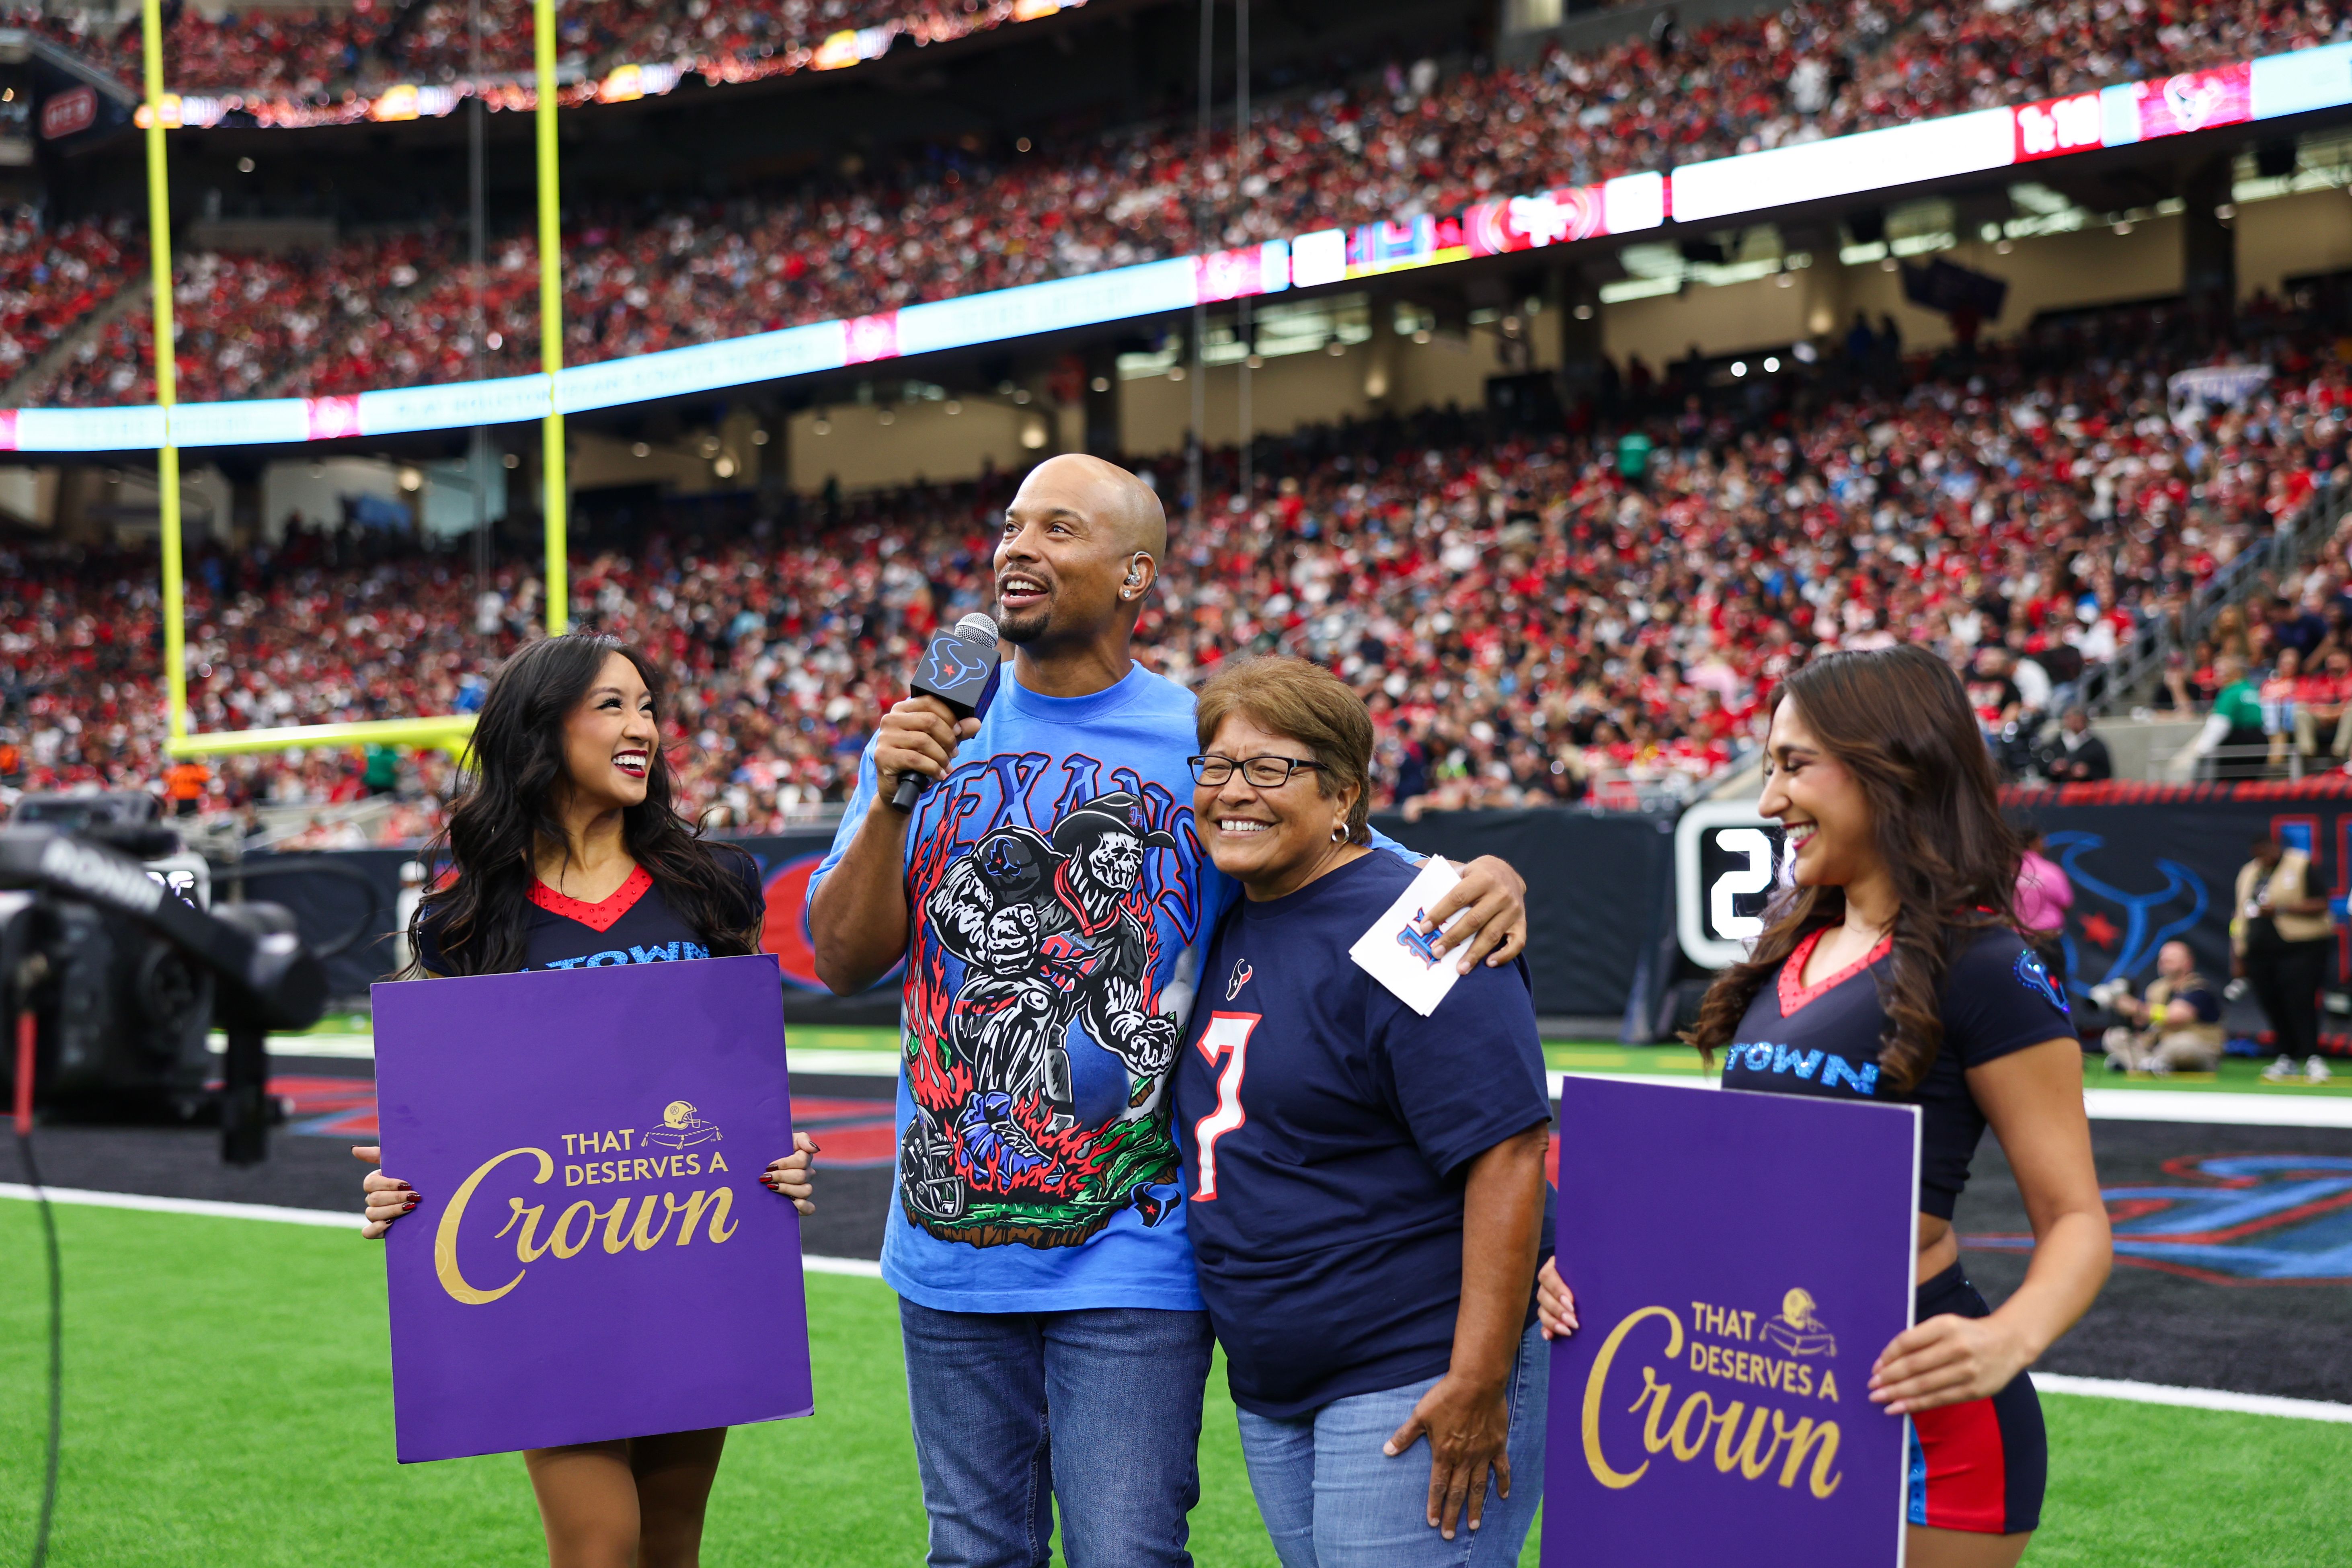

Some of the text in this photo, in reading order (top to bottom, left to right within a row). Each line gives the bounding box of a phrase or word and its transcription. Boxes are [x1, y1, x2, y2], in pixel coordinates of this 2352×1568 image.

[905, 753, 1209, 946] TEXANS
[1711, 828, 1796, 940] 2
[562, 1129, 634, 1155] THAT
[1191, 1010, 1262, 1202] 7
[565, 1151, 729, 1186] DESERVES A
[434, 1147, 739, 1305] Crown
[1690, 1343, 1839, 1403] DESERVES A
[1691, 1301, 1756, 1342] THAT
[1581, 1305, 1843, 1499] Crown
